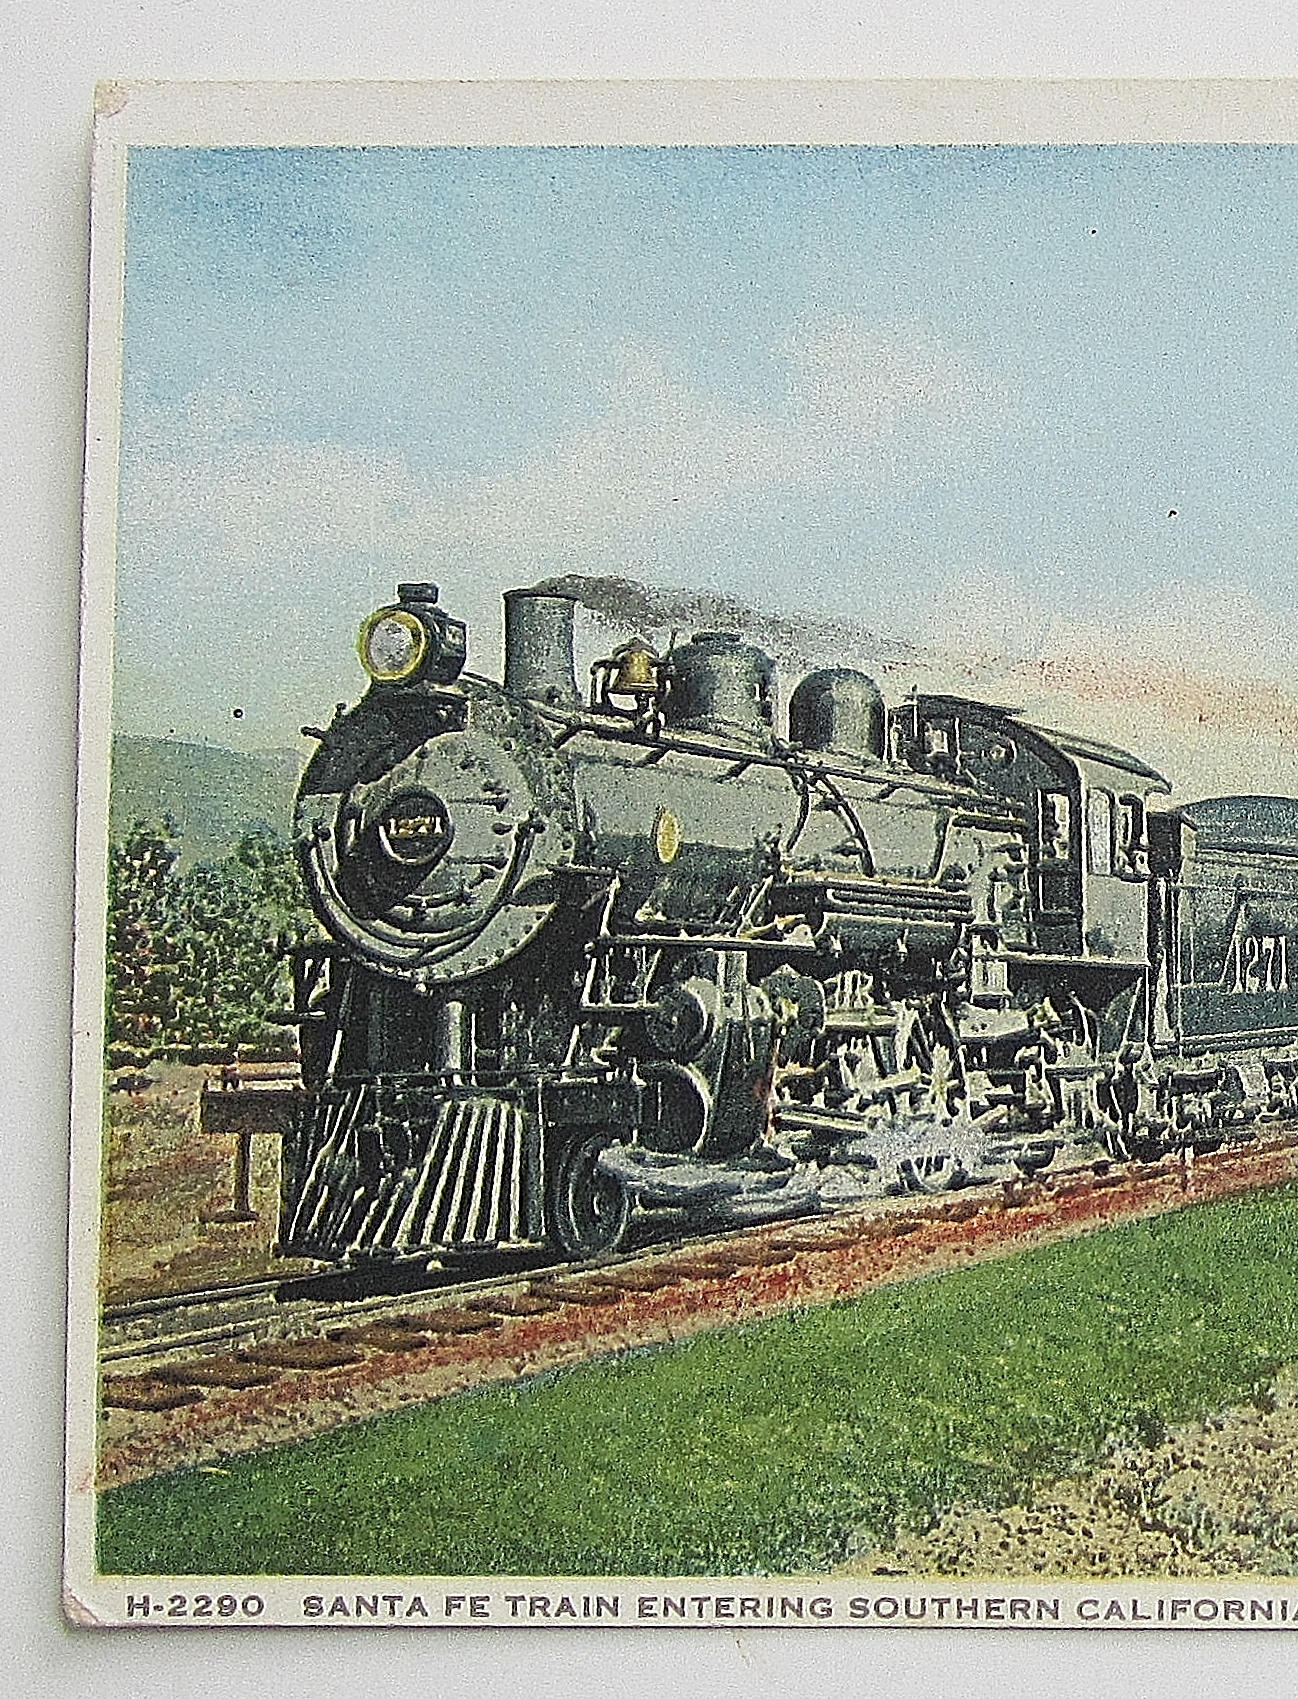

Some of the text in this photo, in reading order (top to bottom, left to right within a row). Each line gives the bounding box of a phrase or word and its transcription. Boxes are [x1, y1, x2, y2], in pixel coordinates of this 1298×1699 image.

[1230, 935, 1289, 994] 1271
[127, 1594, 265, 1618] H-2290
[302, 1594, 428, 1618] SANTA
[444, 1595, 490, 1618] FE
[504, 1595, 619, 1619] TRAIN
[637, 1595, 833, 1619] ENTERING
[849, 1596, 1059, 1622] SOUTHERN
